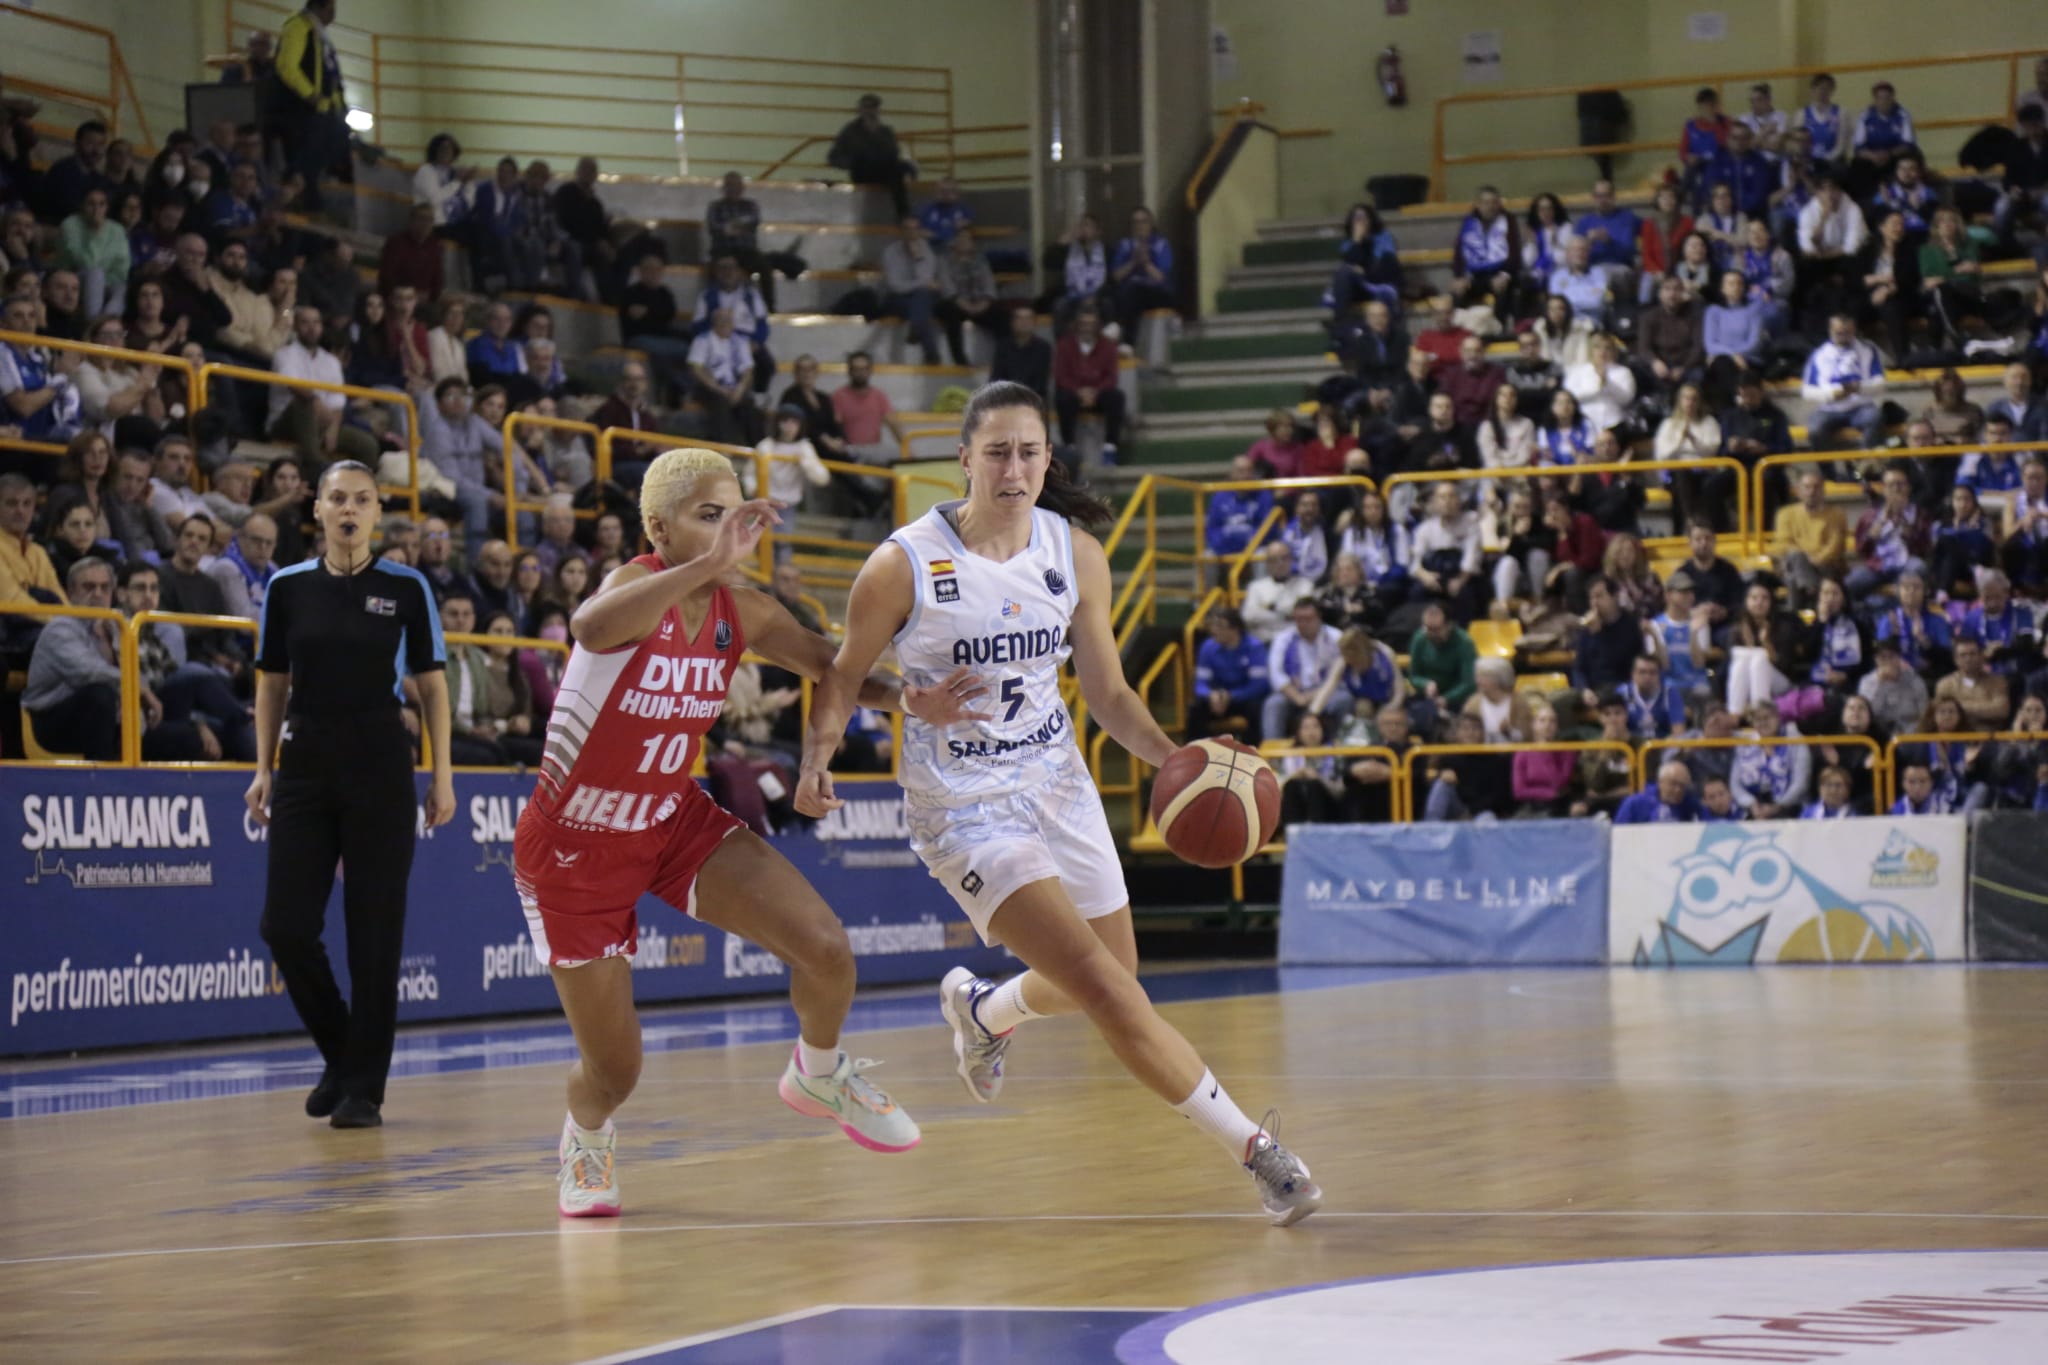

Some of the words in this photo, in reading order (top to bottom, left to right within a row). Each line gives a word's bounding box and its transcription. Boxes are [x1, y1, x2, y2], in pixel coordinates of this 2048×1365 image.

[953, 625, 1060, 665] AVENIDA
[639, 654, 726, 693] DVTK
[1001, 676, 1025, 722] 5
[636, 733, 689, 775] 10
[21, 794, 210, 850] SALAMANCA
[563, 783, 654, 832] HELL
[815, 801, 911, 840] SALAMANC
[76, 861, 131, 885] Patrimonio
[131, 861, 145, 884] de
[145, 861, 156, 883] la
[156, 859, 212, 883] Humanidad
[1306, 874, 1578, 901] MAYBELLINE
